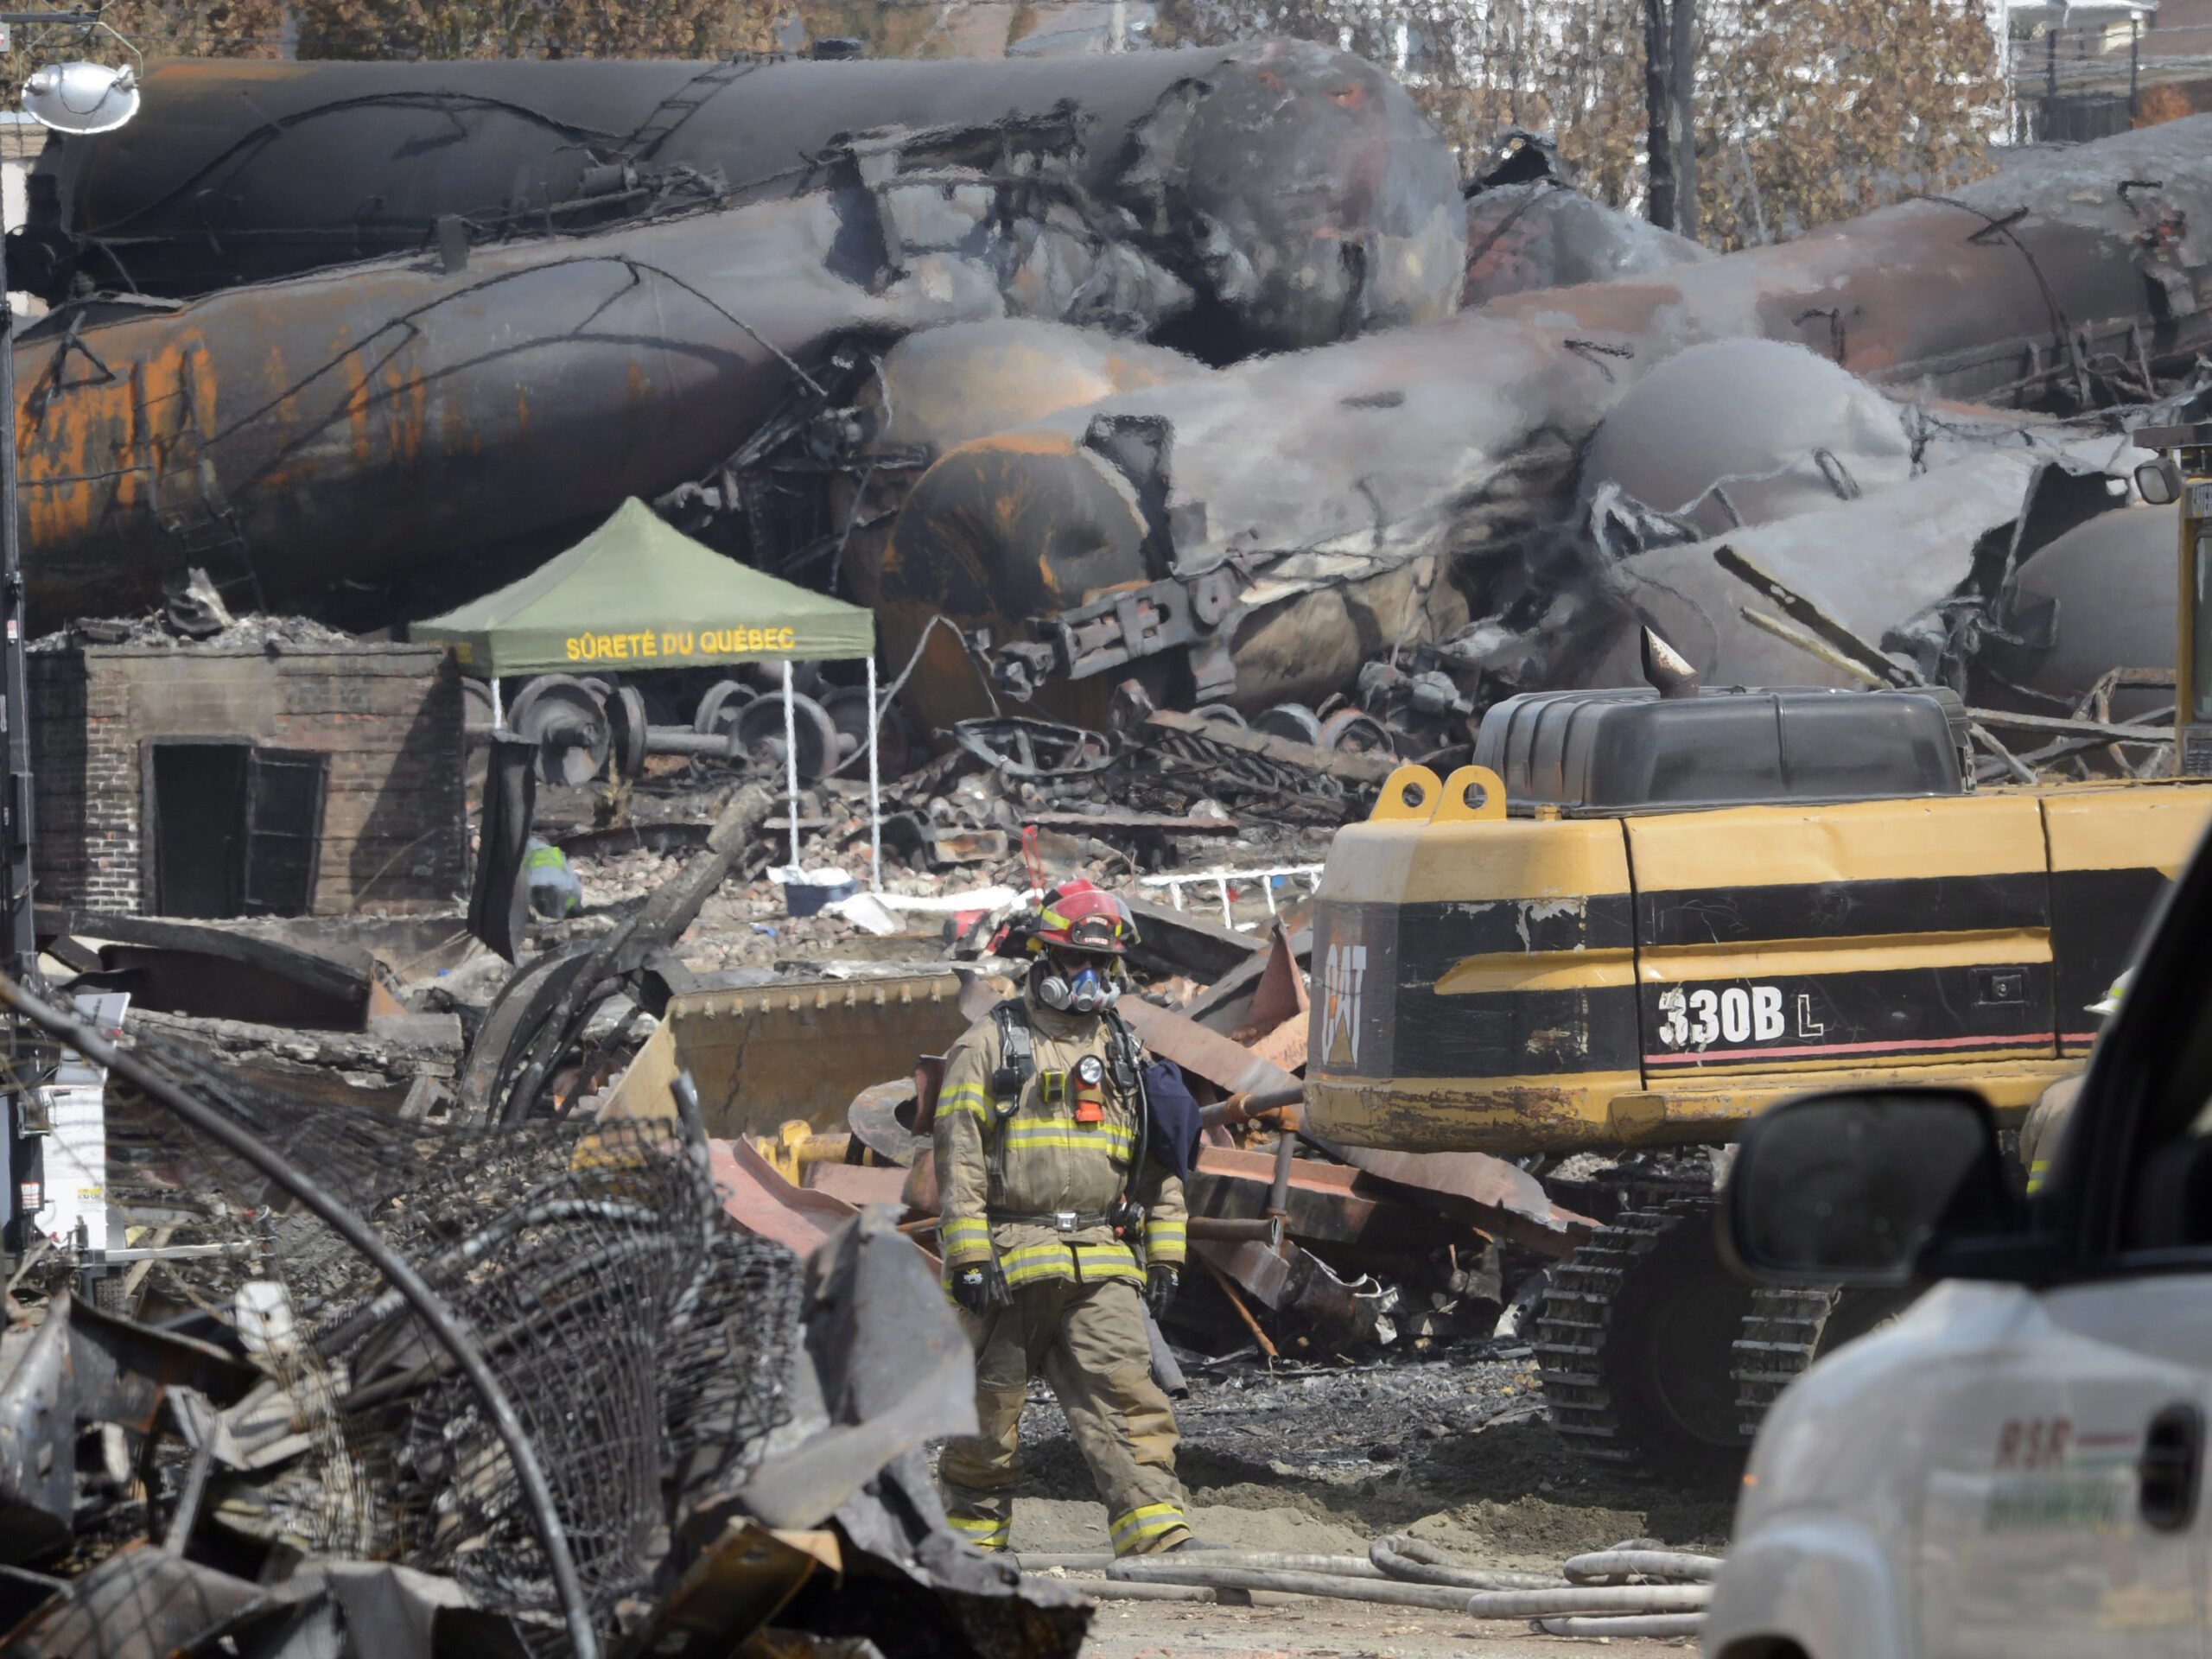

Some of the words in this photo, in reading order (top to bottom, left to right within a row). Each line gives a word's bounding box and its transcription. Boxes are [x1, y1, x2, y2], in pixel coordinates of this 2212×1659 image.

[566, 629, 658, 660] SÛRETÉ
[661, 632, 694, 656] DU
[699, 625, 796, 655] QUÉBEC
[1322, 943, 1367, 1069] CAT
[1658, 986, 1785, 1046] 330B
[1797, 994, 1824, 1037] L
